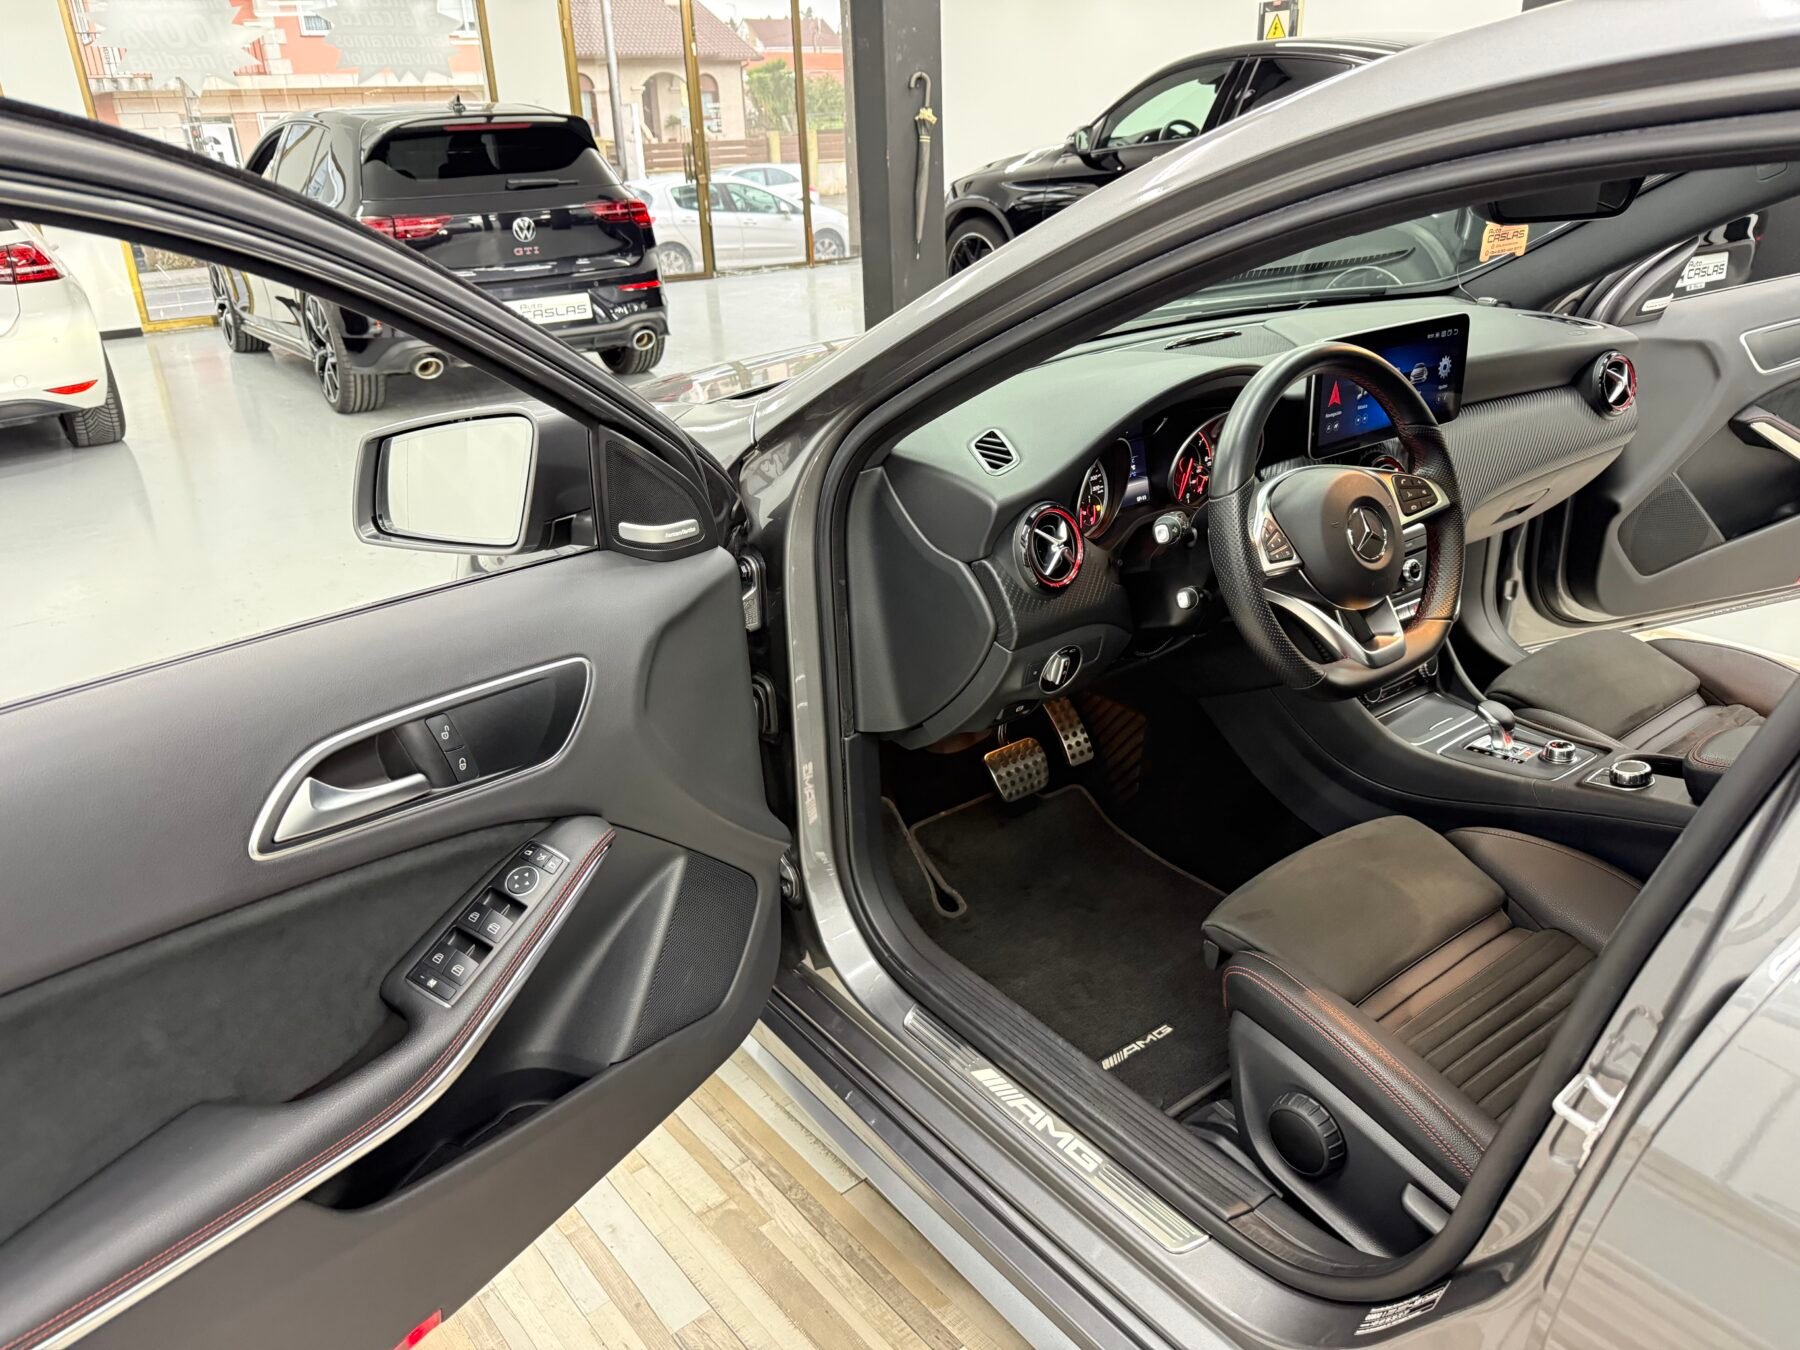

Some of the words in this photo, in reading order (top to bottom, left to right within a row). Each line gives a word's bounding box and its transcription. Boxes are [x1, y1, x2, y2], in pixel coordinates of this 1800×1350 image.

[1487, 229, 1526, 244] CASLAS
[513, 246, 540, 256] GTI
[1687, 263, 1725, 280] CASLAS
[1123, 1024, 1174, 1060] AMG
[1007, 1097, 1103, 1173] AMG
